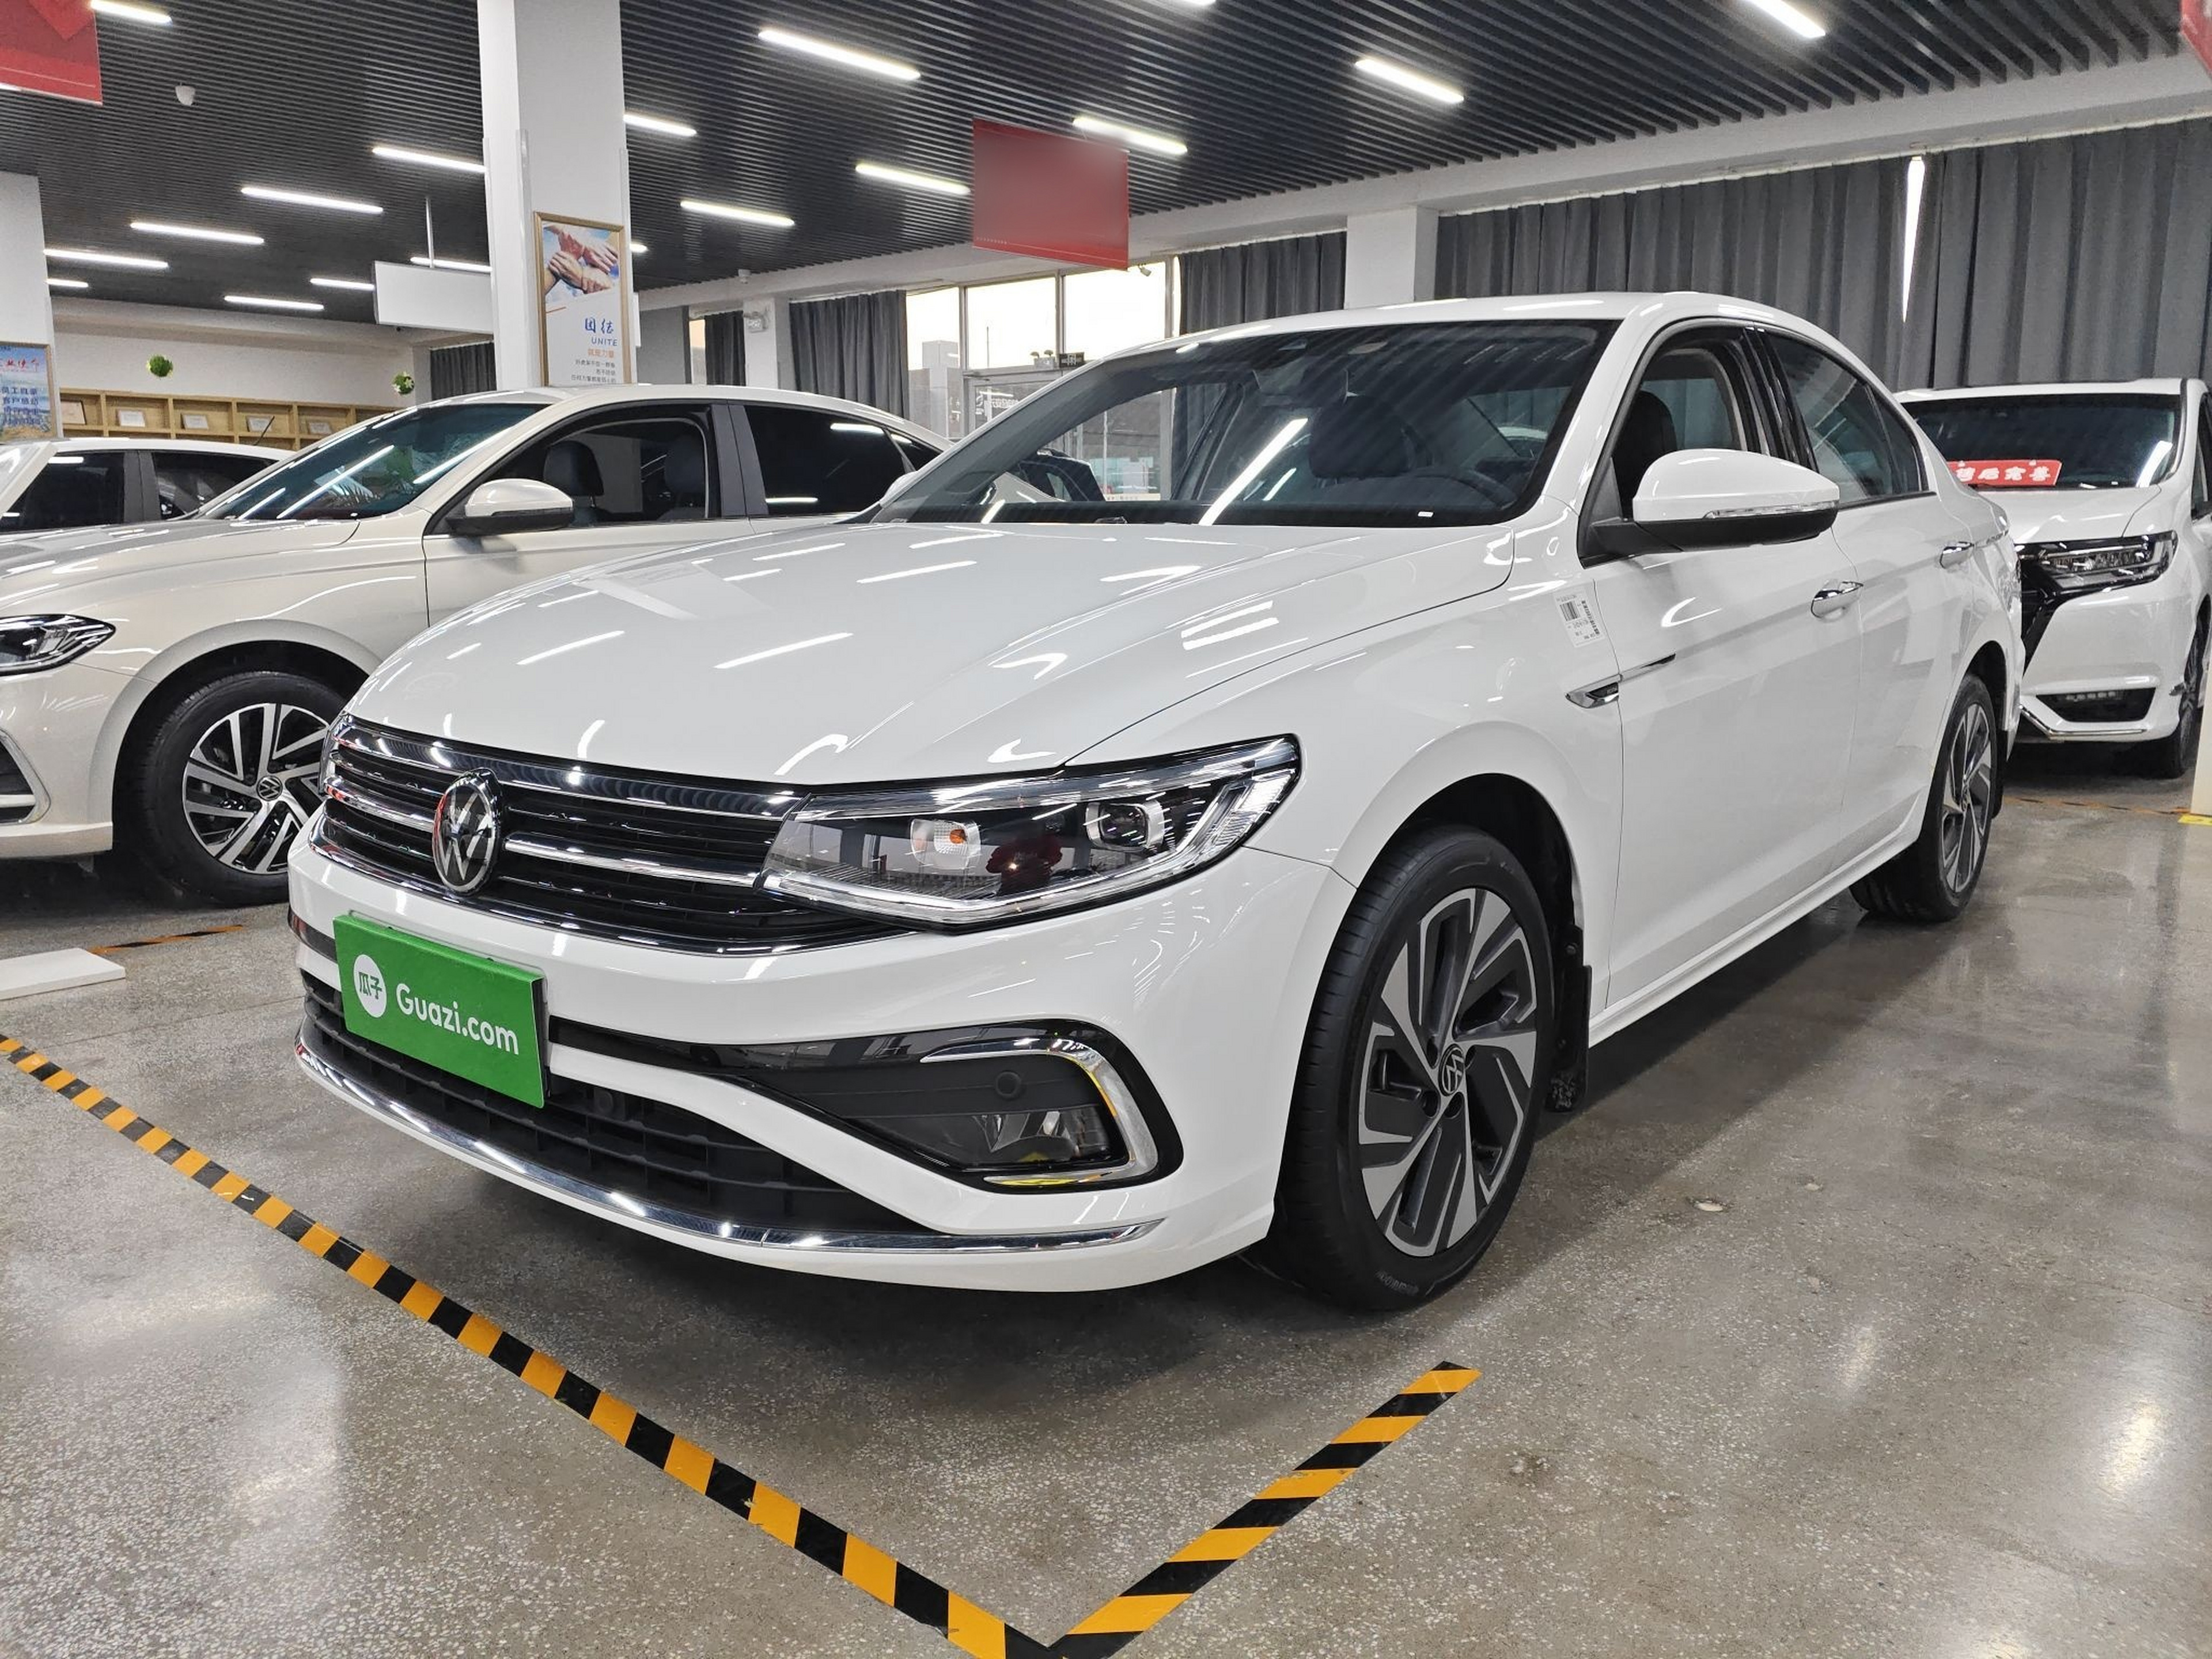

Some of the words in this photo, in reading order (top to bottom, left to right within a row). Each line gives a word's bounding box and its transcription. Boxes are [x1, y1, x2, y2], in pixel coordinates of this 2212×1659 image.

[585, 317, 614, 334] 团结
[591, 337, 618, 346] UNITE
[358, 971, 382, 1000] 瓜子
[396, 983, 518, 1055] Guazi.com
